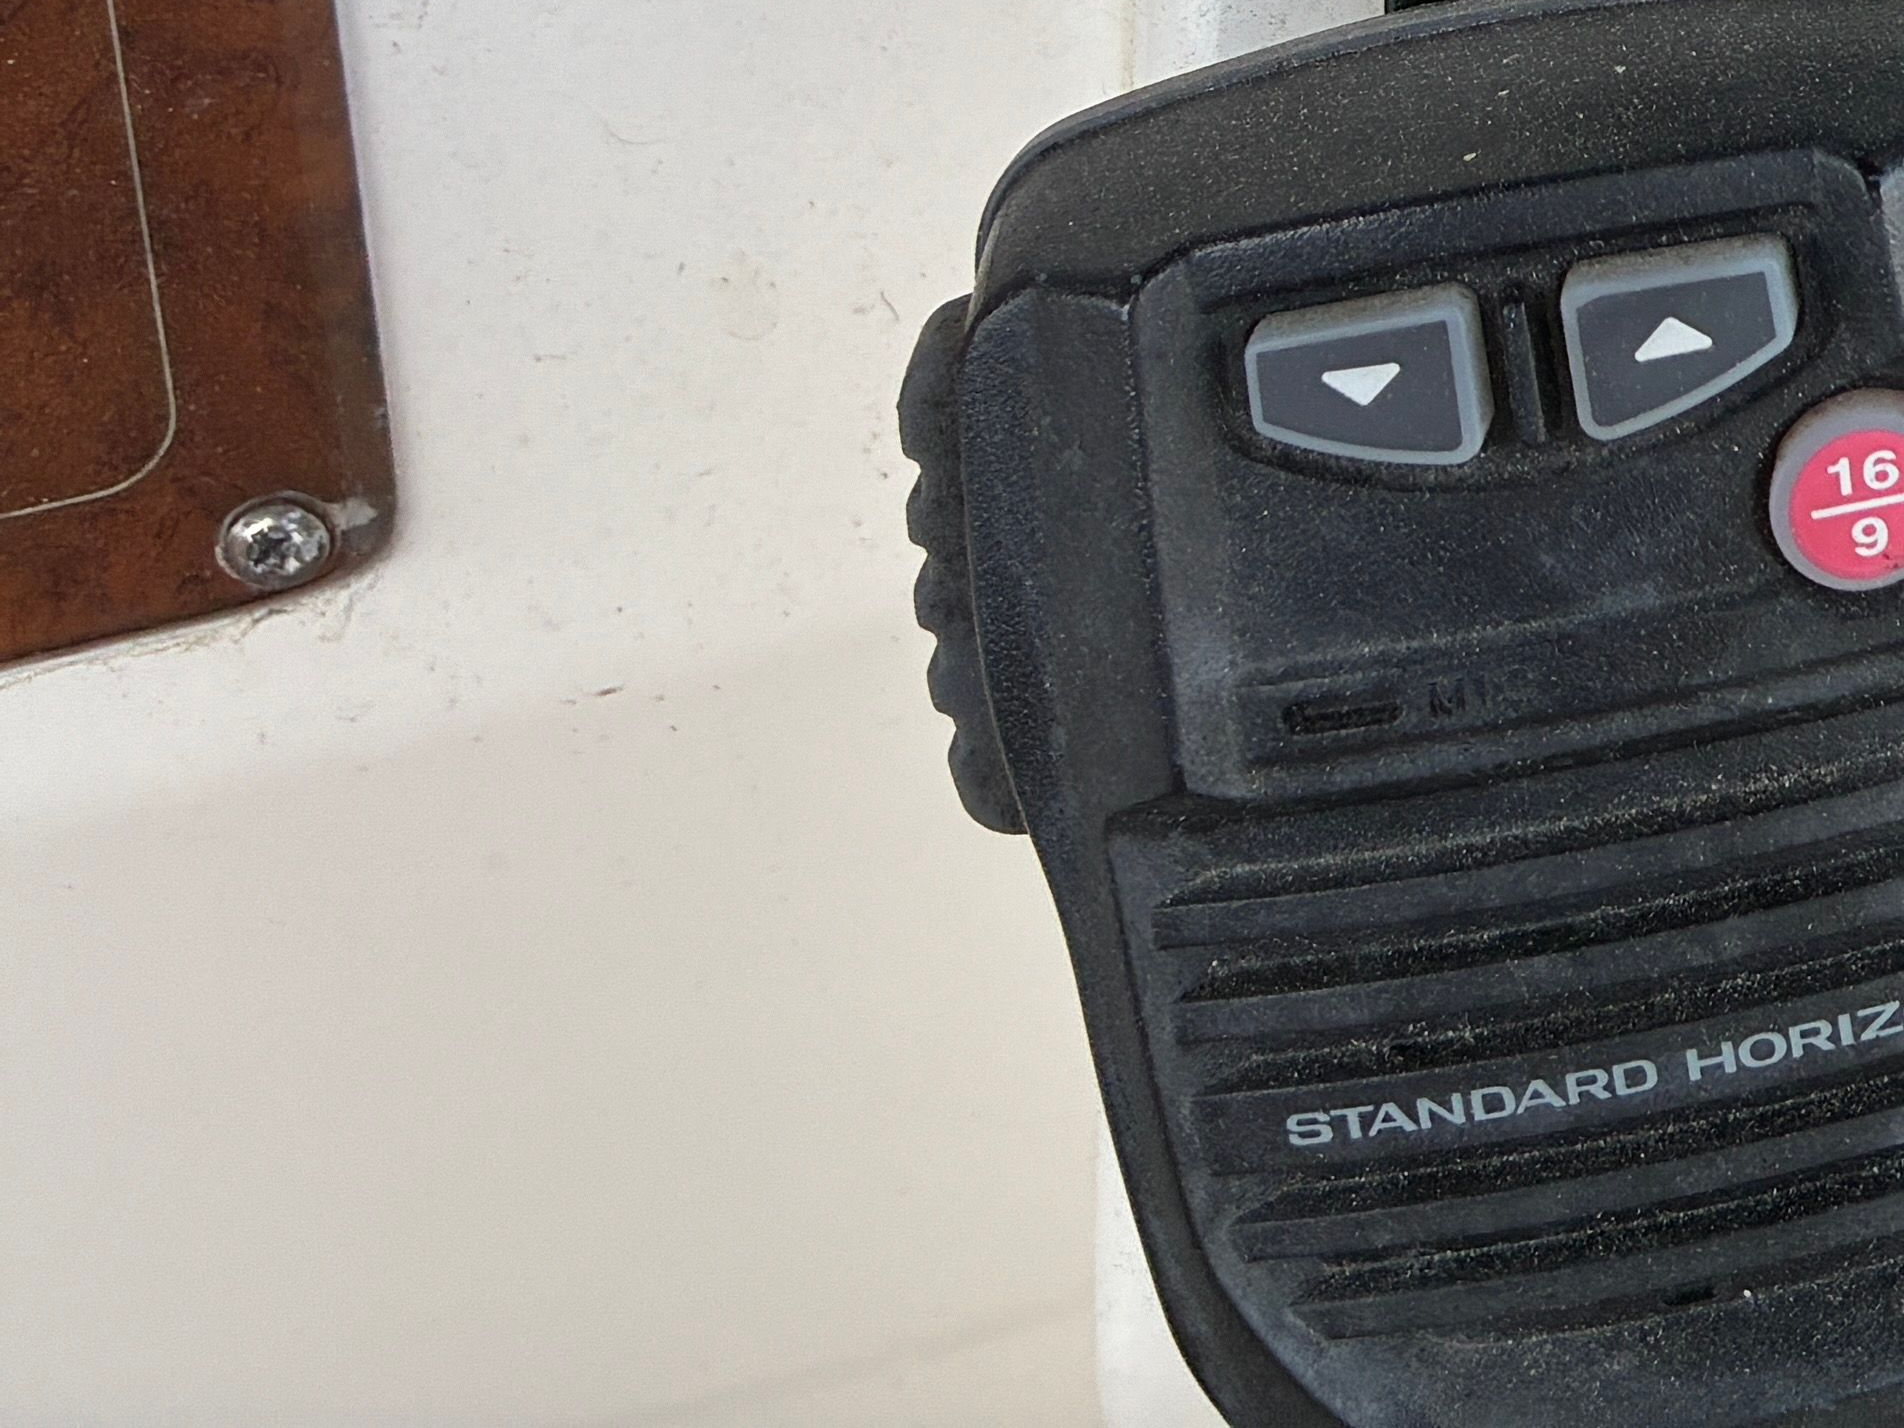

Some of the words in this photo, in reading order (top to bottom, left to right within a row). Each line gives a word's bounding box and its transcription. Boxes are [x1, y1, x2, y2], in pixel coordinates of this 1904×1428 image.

[1826, 449, 1900, 496] 16
[1851, 516, 1889, 557] 9
[1286, 1058, 1658, 1146] STANDARD
